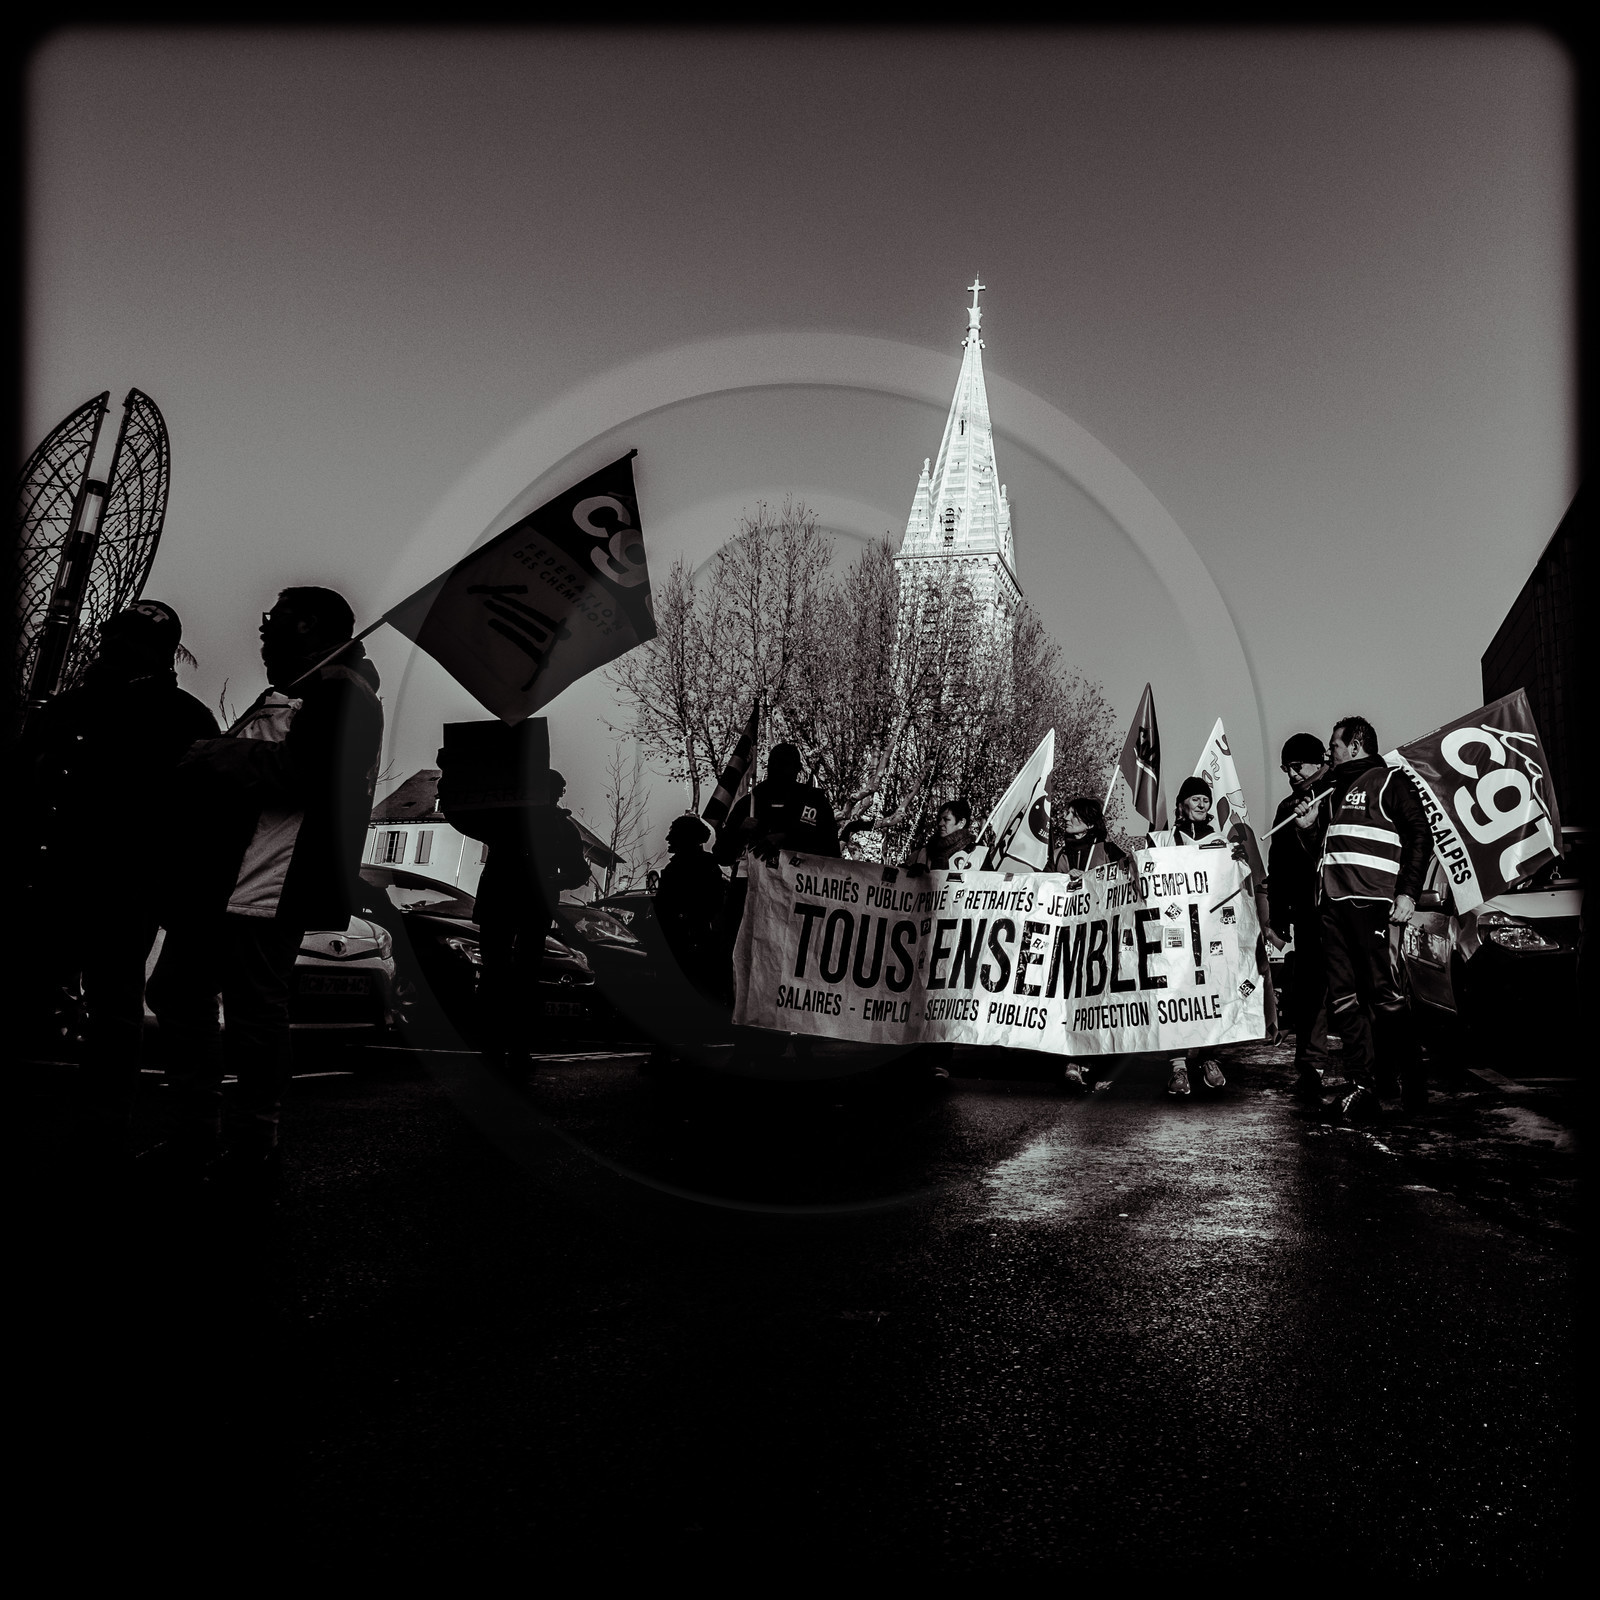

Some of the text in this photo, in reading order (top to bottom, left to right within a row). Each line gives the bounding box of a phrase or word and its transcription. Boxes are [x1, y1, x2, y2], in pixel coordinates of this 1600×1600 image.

[513, 550, 612, 635] DES CHEMINOTS
[572, 496, 653, 618] cg
[1441, 727, 1557, 883] cgt
[795, 873, 860, 904] SALARIÉS
[964, 886, 1034, 913] RETRAITÉS
[1047, 893, 1091, 917] JEUNES
[1140, 871, 1208, 899] D'EMPLOI
[794, 902, 917, 993] TOUS
[926, 908, 1168, 1000] ENSEMBLE
[777, 985, 842, 1016] SALAIRES
[925, 999, 979, 1021] SERVICES
[988, 1001, 1047, 1030] PUBLICS
[1073, 1001, 1150, 1031] PROTECTION
[1158, 995, 1222, 1025] SOCIALE
